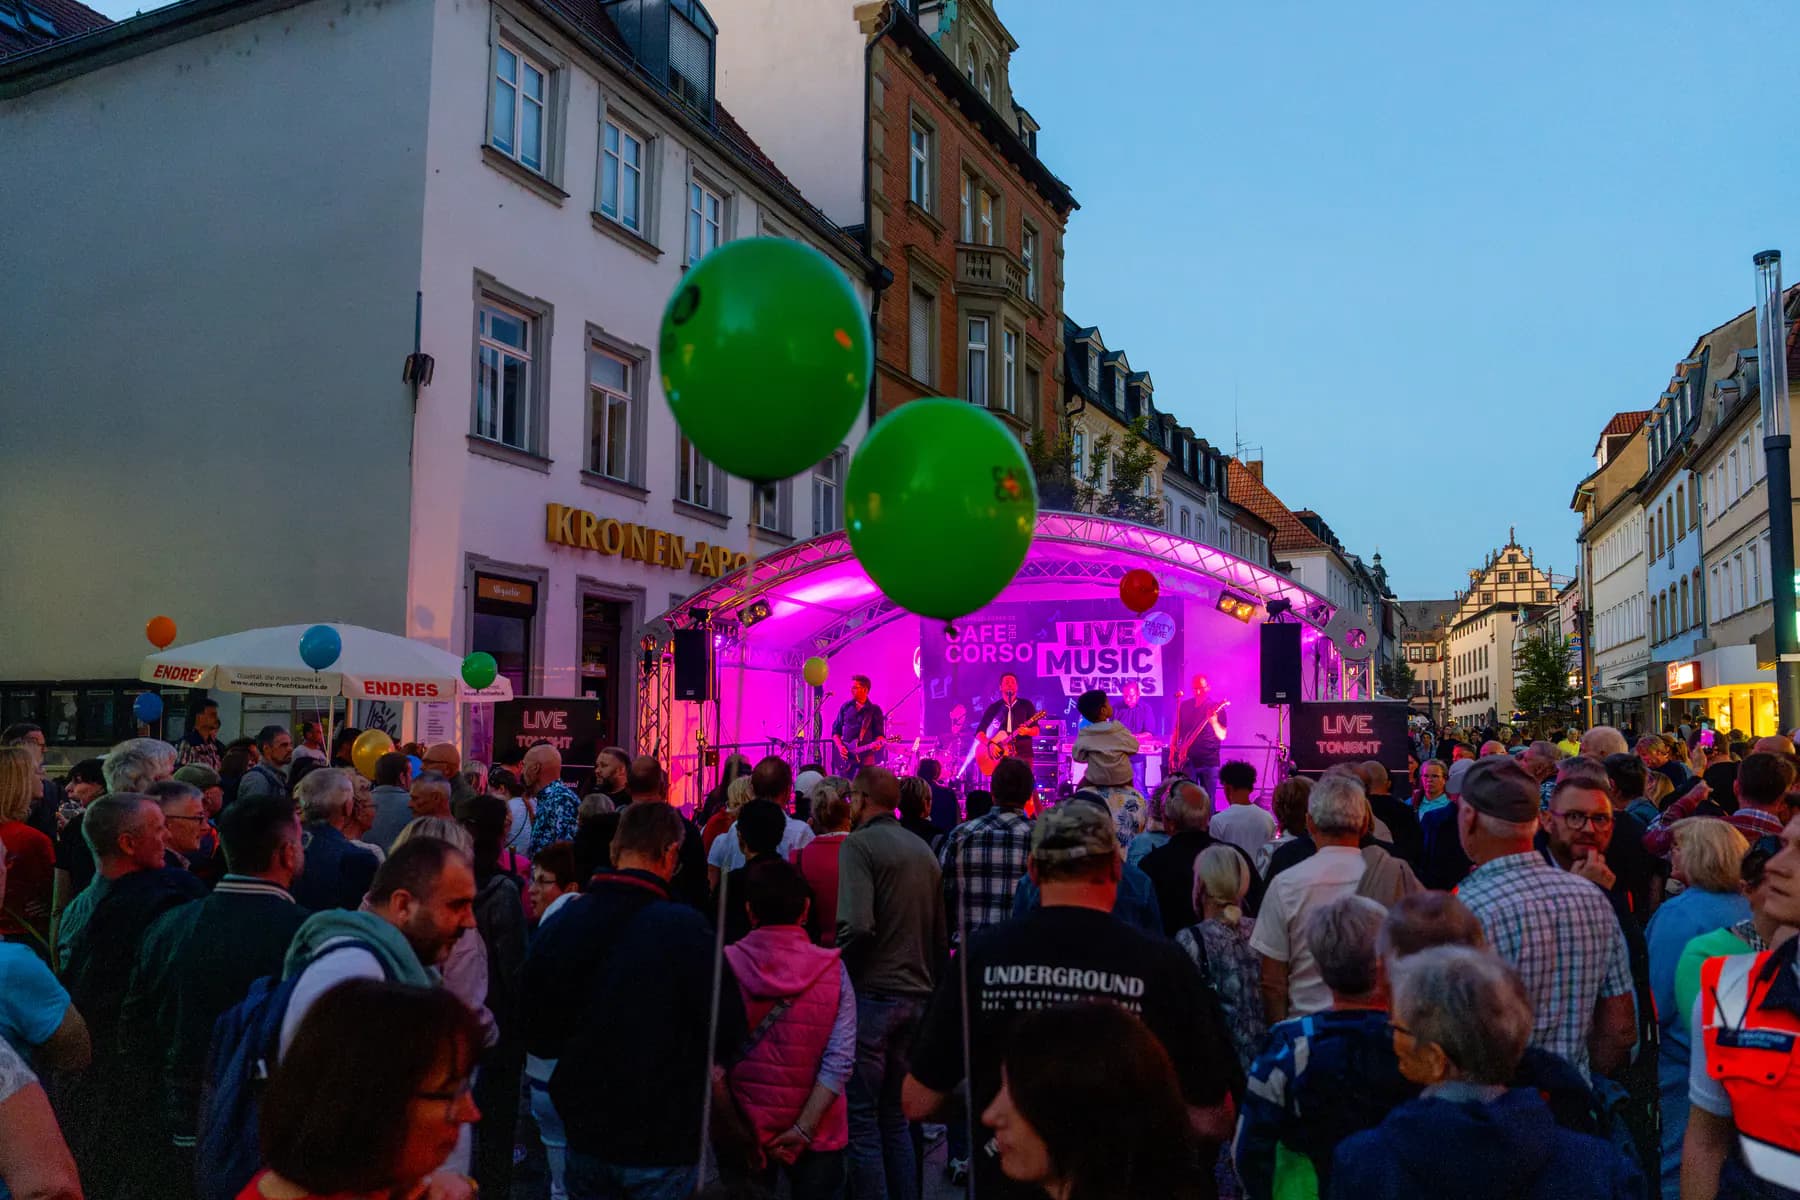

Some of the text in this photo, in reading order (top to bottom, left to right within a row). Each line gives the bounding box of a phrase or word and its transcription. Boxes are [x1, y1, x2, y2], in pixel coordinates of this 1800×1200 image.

[945, 623, 1007, 643] CAFE
[1065, 622, 1136, 646] LIVE
[1145, 620, 1173, 632] PARTY
[1148, 628, 1168, 639] TIME
[945, 643, 1033, 663] CORSO
[1045, 647, 1154, 675] MUSIC
[364, 681, 439, 697] ENDRES
[523, 710, 568, 730] LIVE
[1323, 715, 1374, 735] LIVE
[515, 735, 573, 750] TOGHT
[1316, 740, 1382, 754] TONIGHT
[984, 965, 1144, 997] UNDERGROUND
